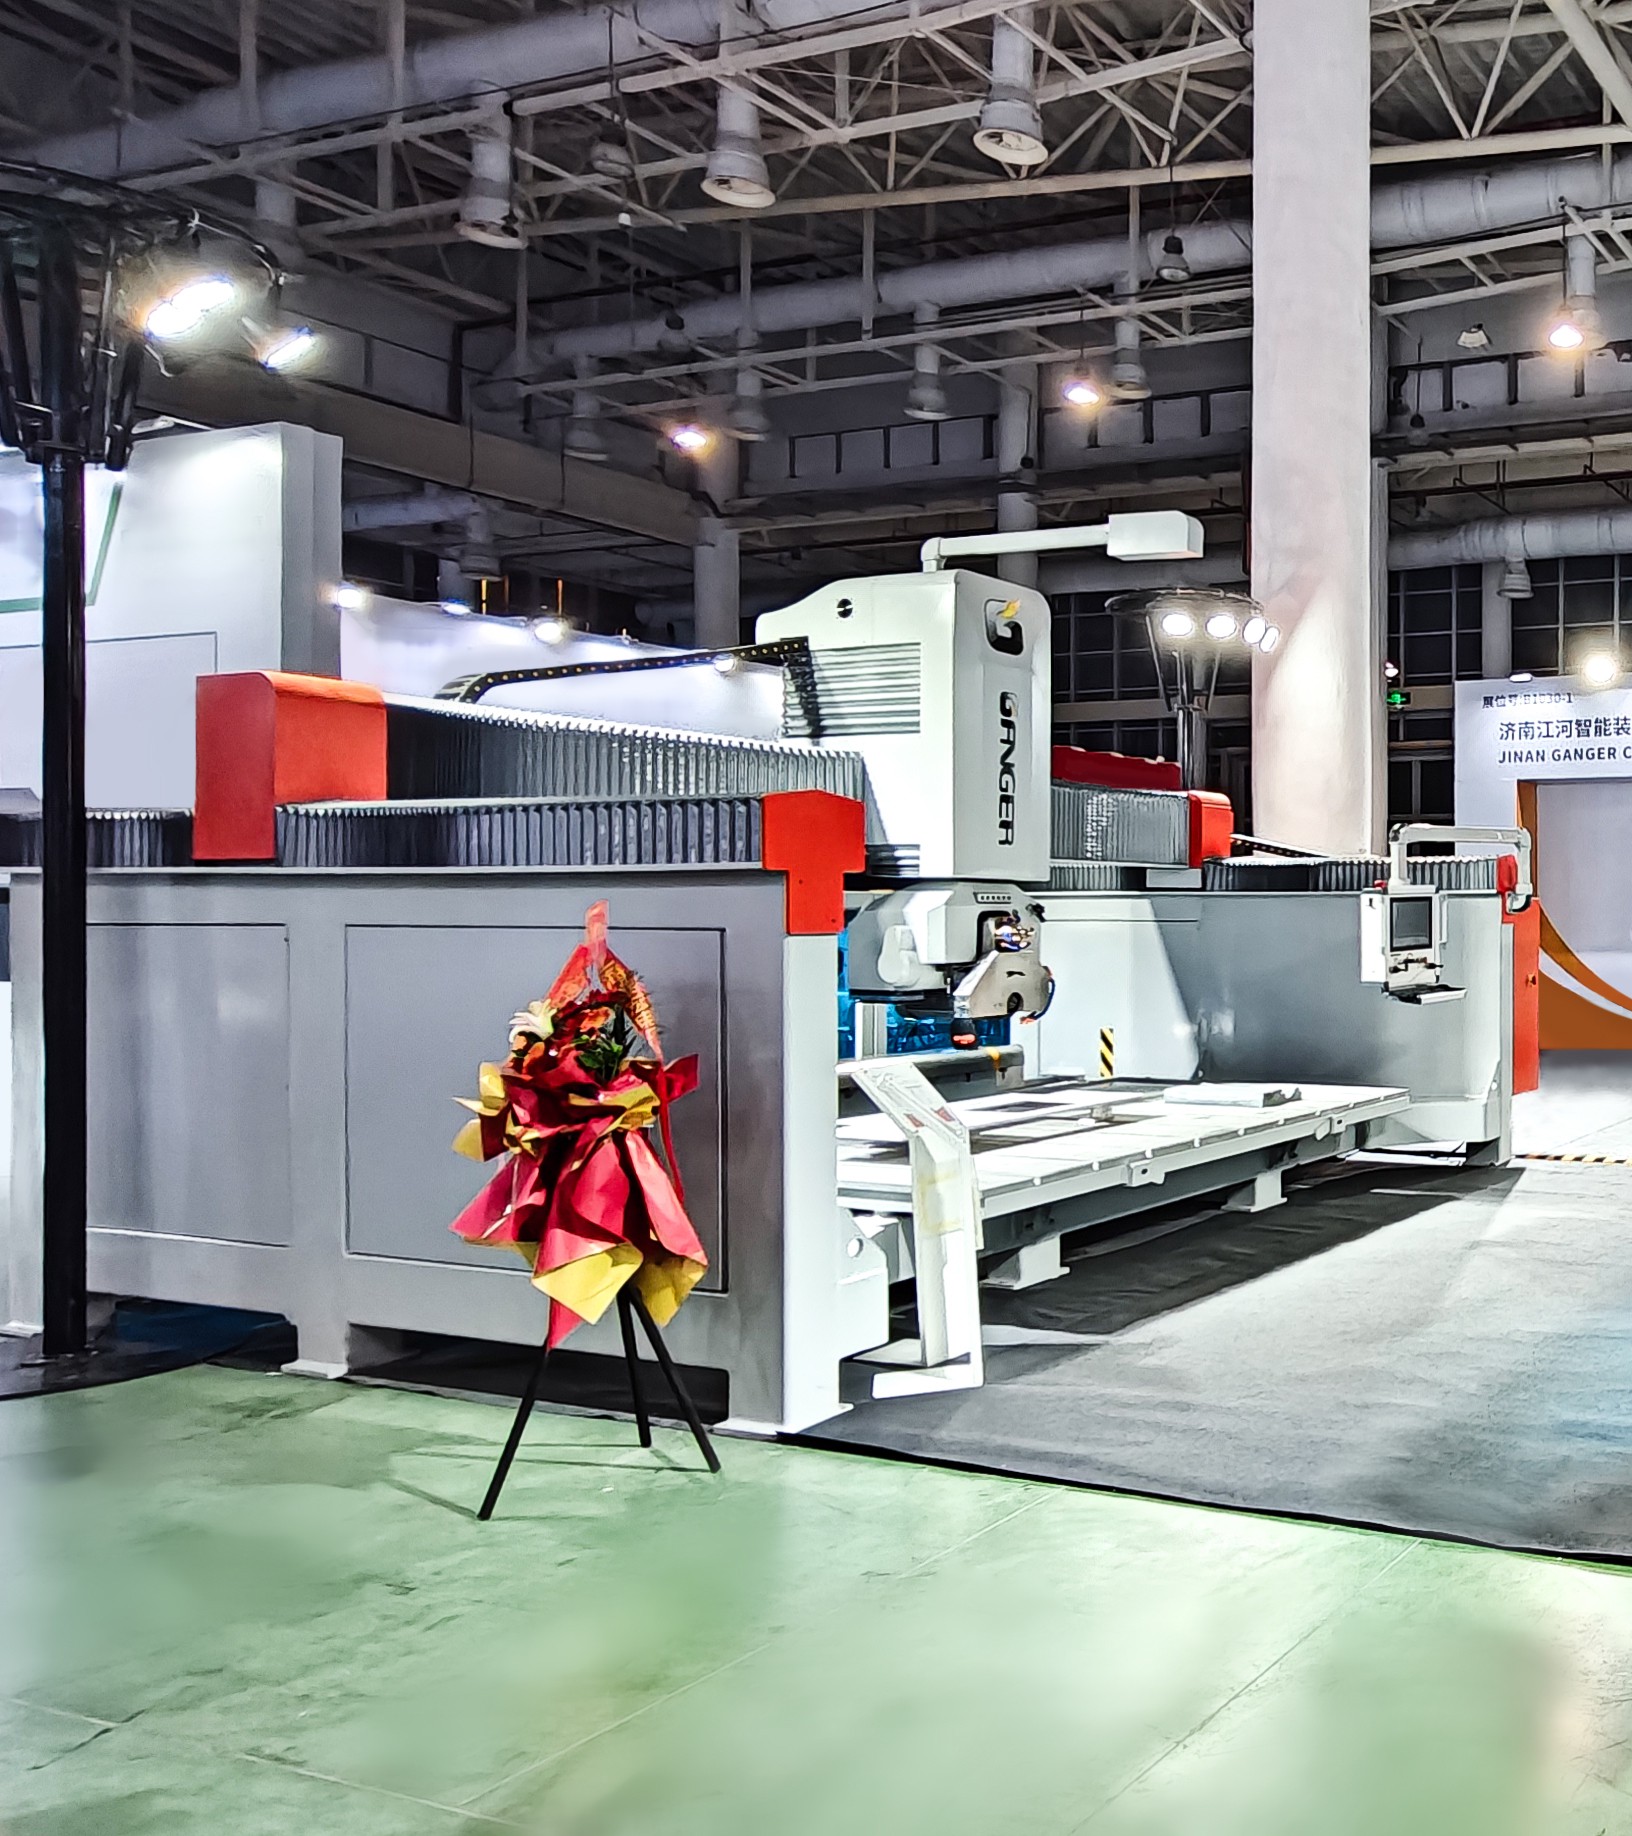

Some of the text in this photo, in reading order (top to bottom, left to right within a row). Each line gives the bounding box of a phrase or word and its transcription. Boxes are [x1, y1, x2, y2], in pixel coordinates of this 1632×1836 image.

[998, 691, 1017, 846] GANGER
[1499, 750, 1546, 764] JINAN
[1551, 747, 1617, 762] GANGER
